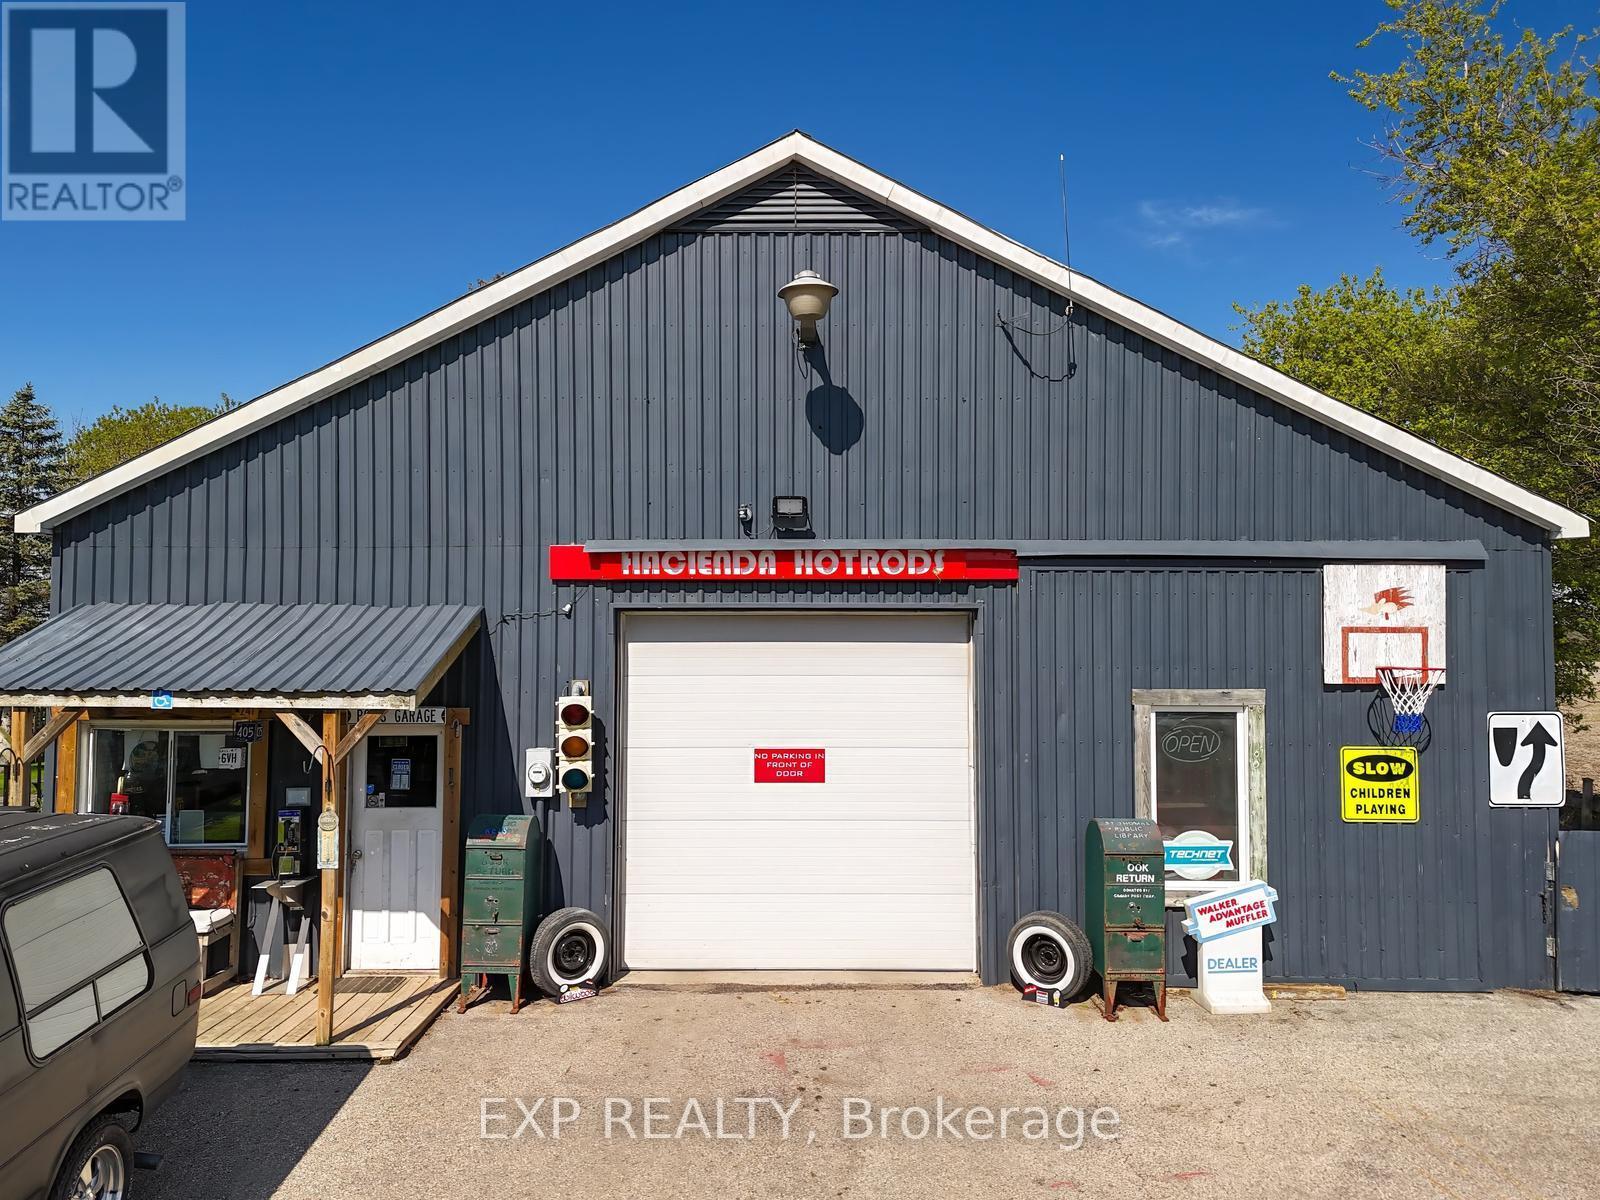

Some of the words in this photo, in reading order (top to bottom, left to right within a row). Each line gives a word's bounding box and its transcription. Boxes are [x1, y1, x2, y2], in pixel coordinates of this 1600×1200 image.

[621, 550, 776, 575] HACIENDA
[794, 550, 945, 575] HOTRODS
[395, 709, 437, 723] GARAGE
[237, 726, 254, 738] 405
[1165, 735, 1215, 753] OPEN
[1352, 761, 1406, 775] SLOW
[1350, 788, 1411, 799] CHILDREN
[1356, 804, 1406, 815] PLAYING
[1116, 874, 1155, 883] RETURN
[1209, 900, 1266, 923] ADVANTAGE
[1225, 909, 1268, 928] MUFFLER
[1207, 957, 1258, 969] DEALER
